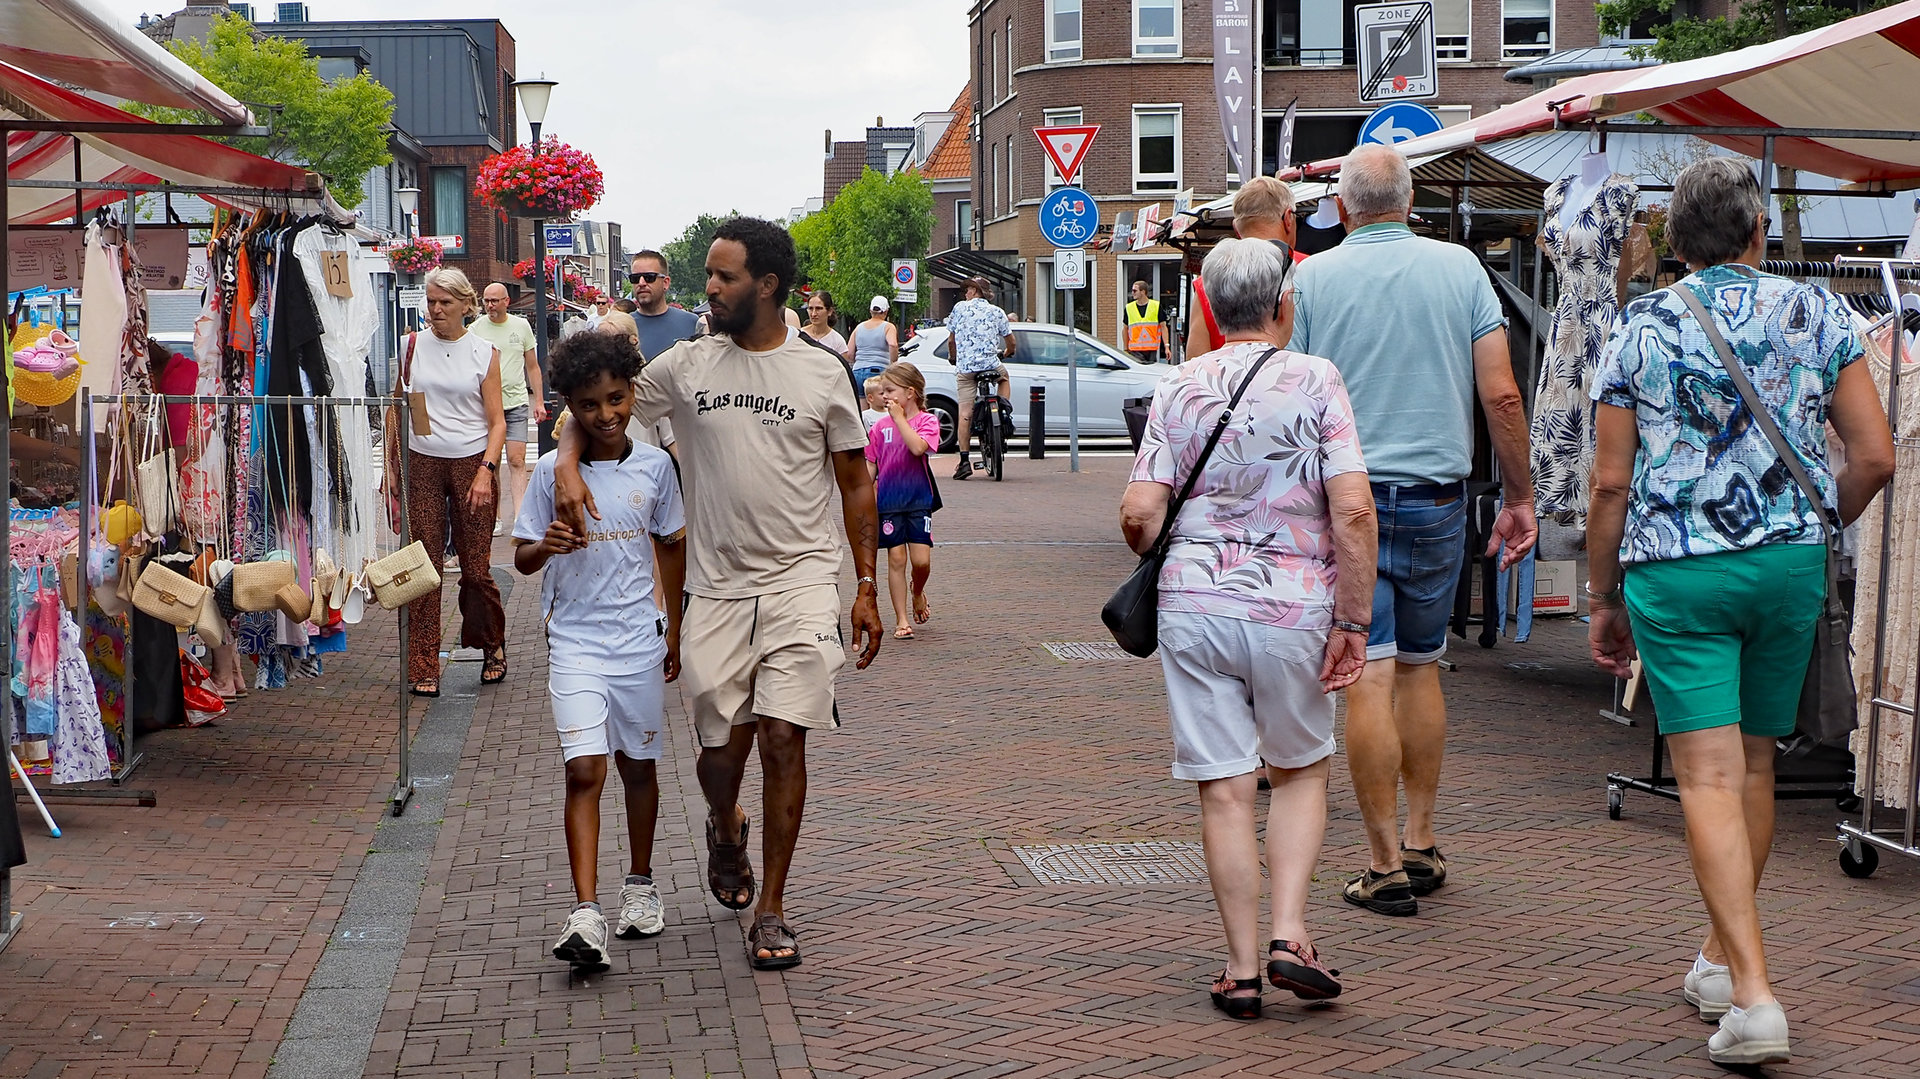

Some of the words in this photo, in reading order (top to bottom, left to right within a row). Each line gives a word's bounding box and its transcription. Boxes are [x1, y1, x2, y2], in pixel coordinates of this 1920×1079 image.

[1378, 9, 1411, 20] ZONE
[1216, 19, 1248, 27] BAROM
[1408, 83, 1415, 92] 2
[1419, 83, 1426, 91] h
[695, 389, 731, 416] Los
[735, 394, 797, 425] angeles
[762, 419, 781, 427] CITY
[881, 427, 893, 443] 10
